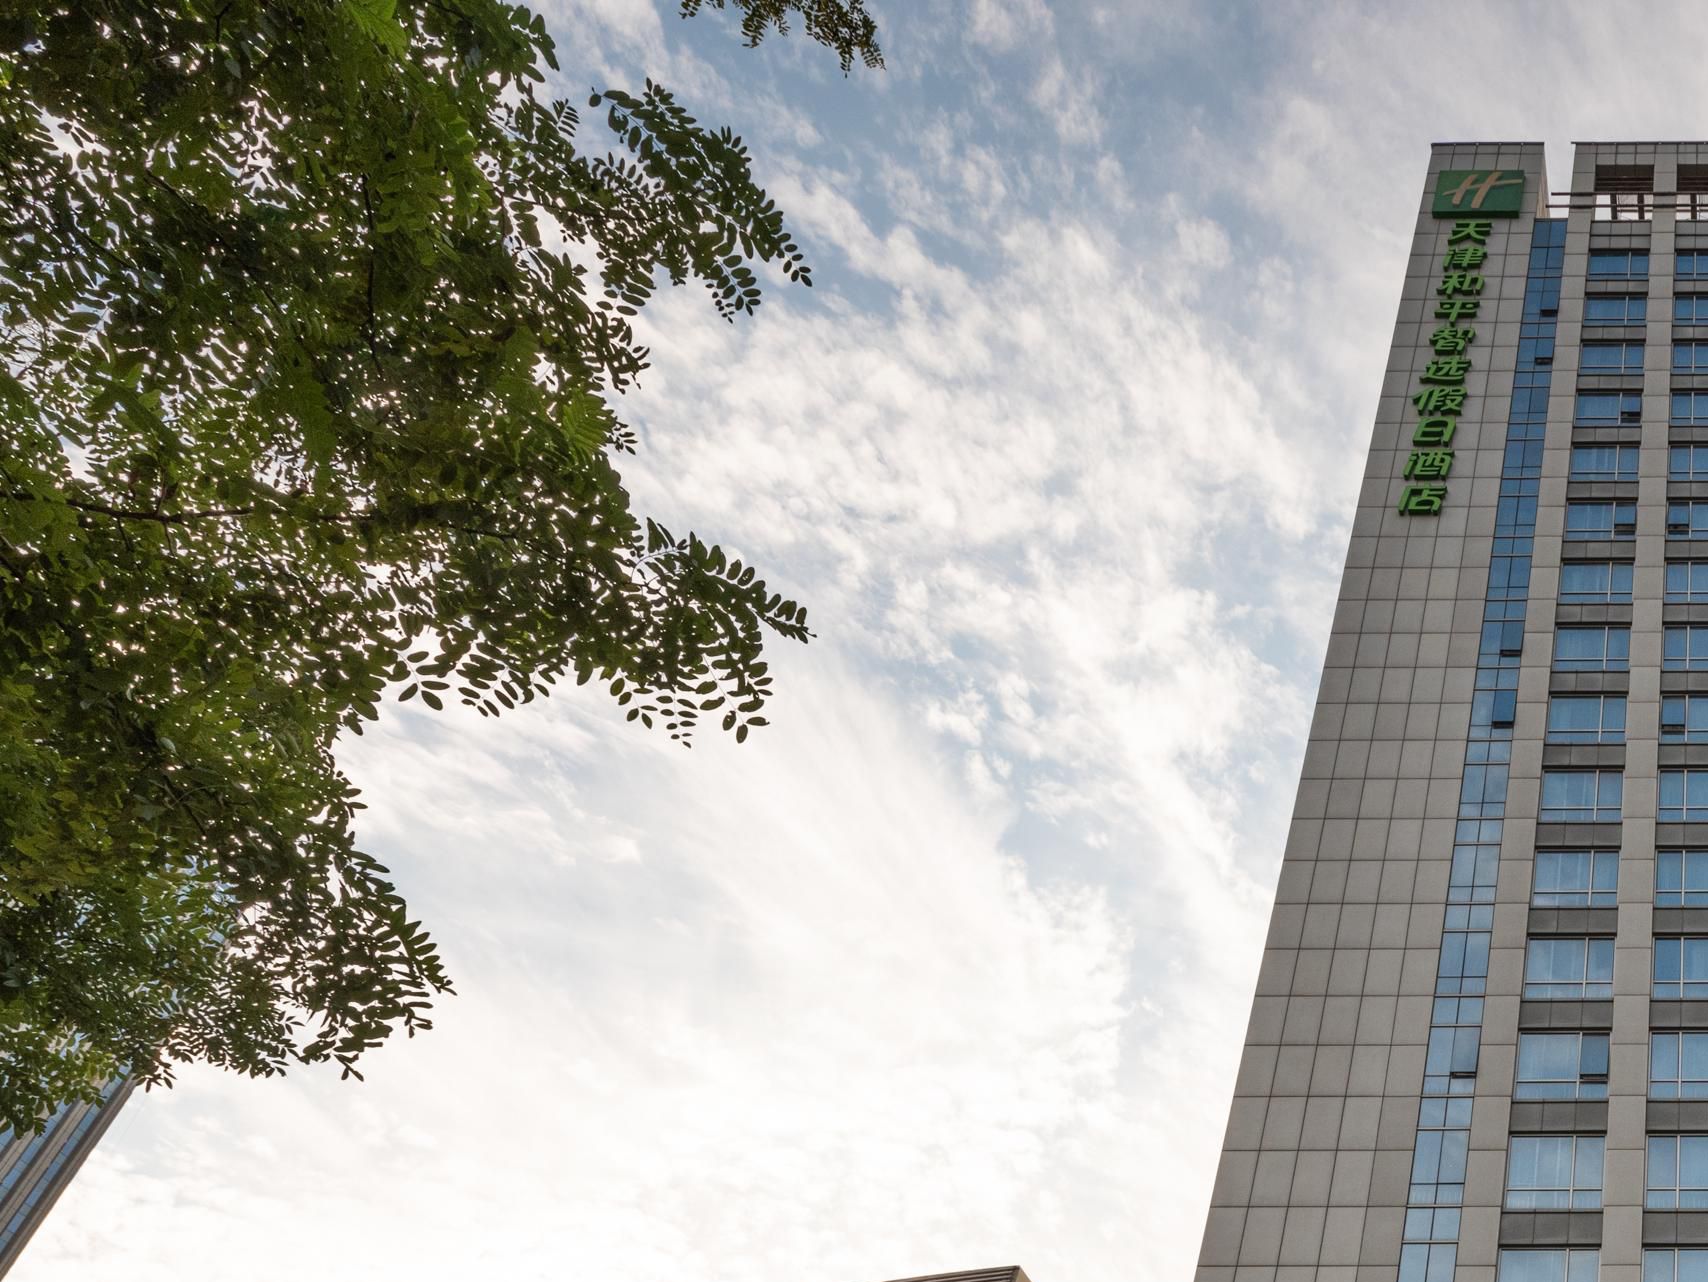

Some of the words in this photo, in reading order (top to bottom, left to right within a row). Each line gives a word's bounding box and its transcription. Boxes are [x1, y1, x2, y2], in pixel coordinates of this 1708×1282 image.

[1398, 220, 1493, 516] 天津和平智选假日酒店
